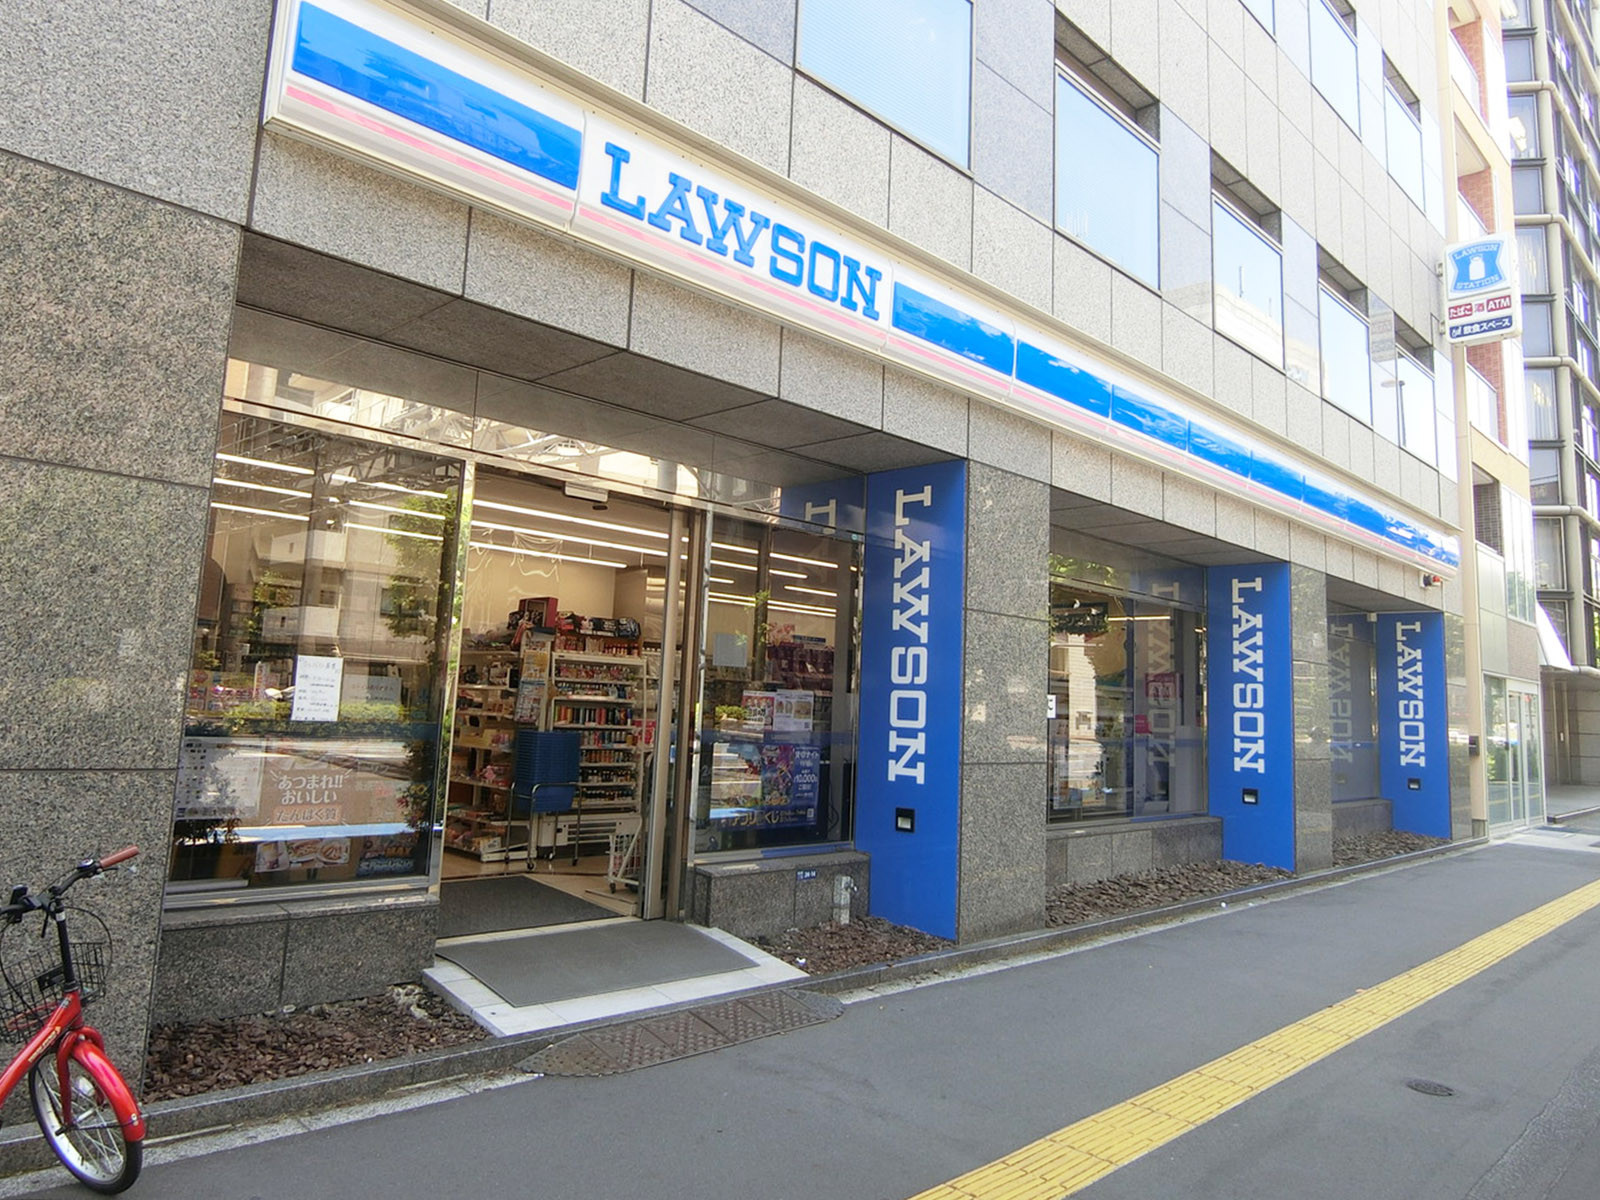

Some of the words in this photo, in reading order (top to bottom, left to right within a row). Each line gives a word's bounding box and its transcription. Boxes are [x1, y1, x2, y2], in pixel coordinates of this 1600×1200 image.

[601, 142, 882, 321] LAWSON
[1454, 243, 1499, 260] LAWSON
[1456, 274, 1500, 290] STATION
[1449, 304, 1472, 318] たばこ
[1488, 296, 1511, 310] ATM
[1463, 318, 1511, 335] 飲食スペース
[888, 485, 932, 785] LAWSON
[1232, 577, 1264, 773] LAWSON
[1396, 621, 1425, 767] LAWSON
[278, 774, 343, 790] あつまれ!!
[281, 790, 337, 805] おいしい
